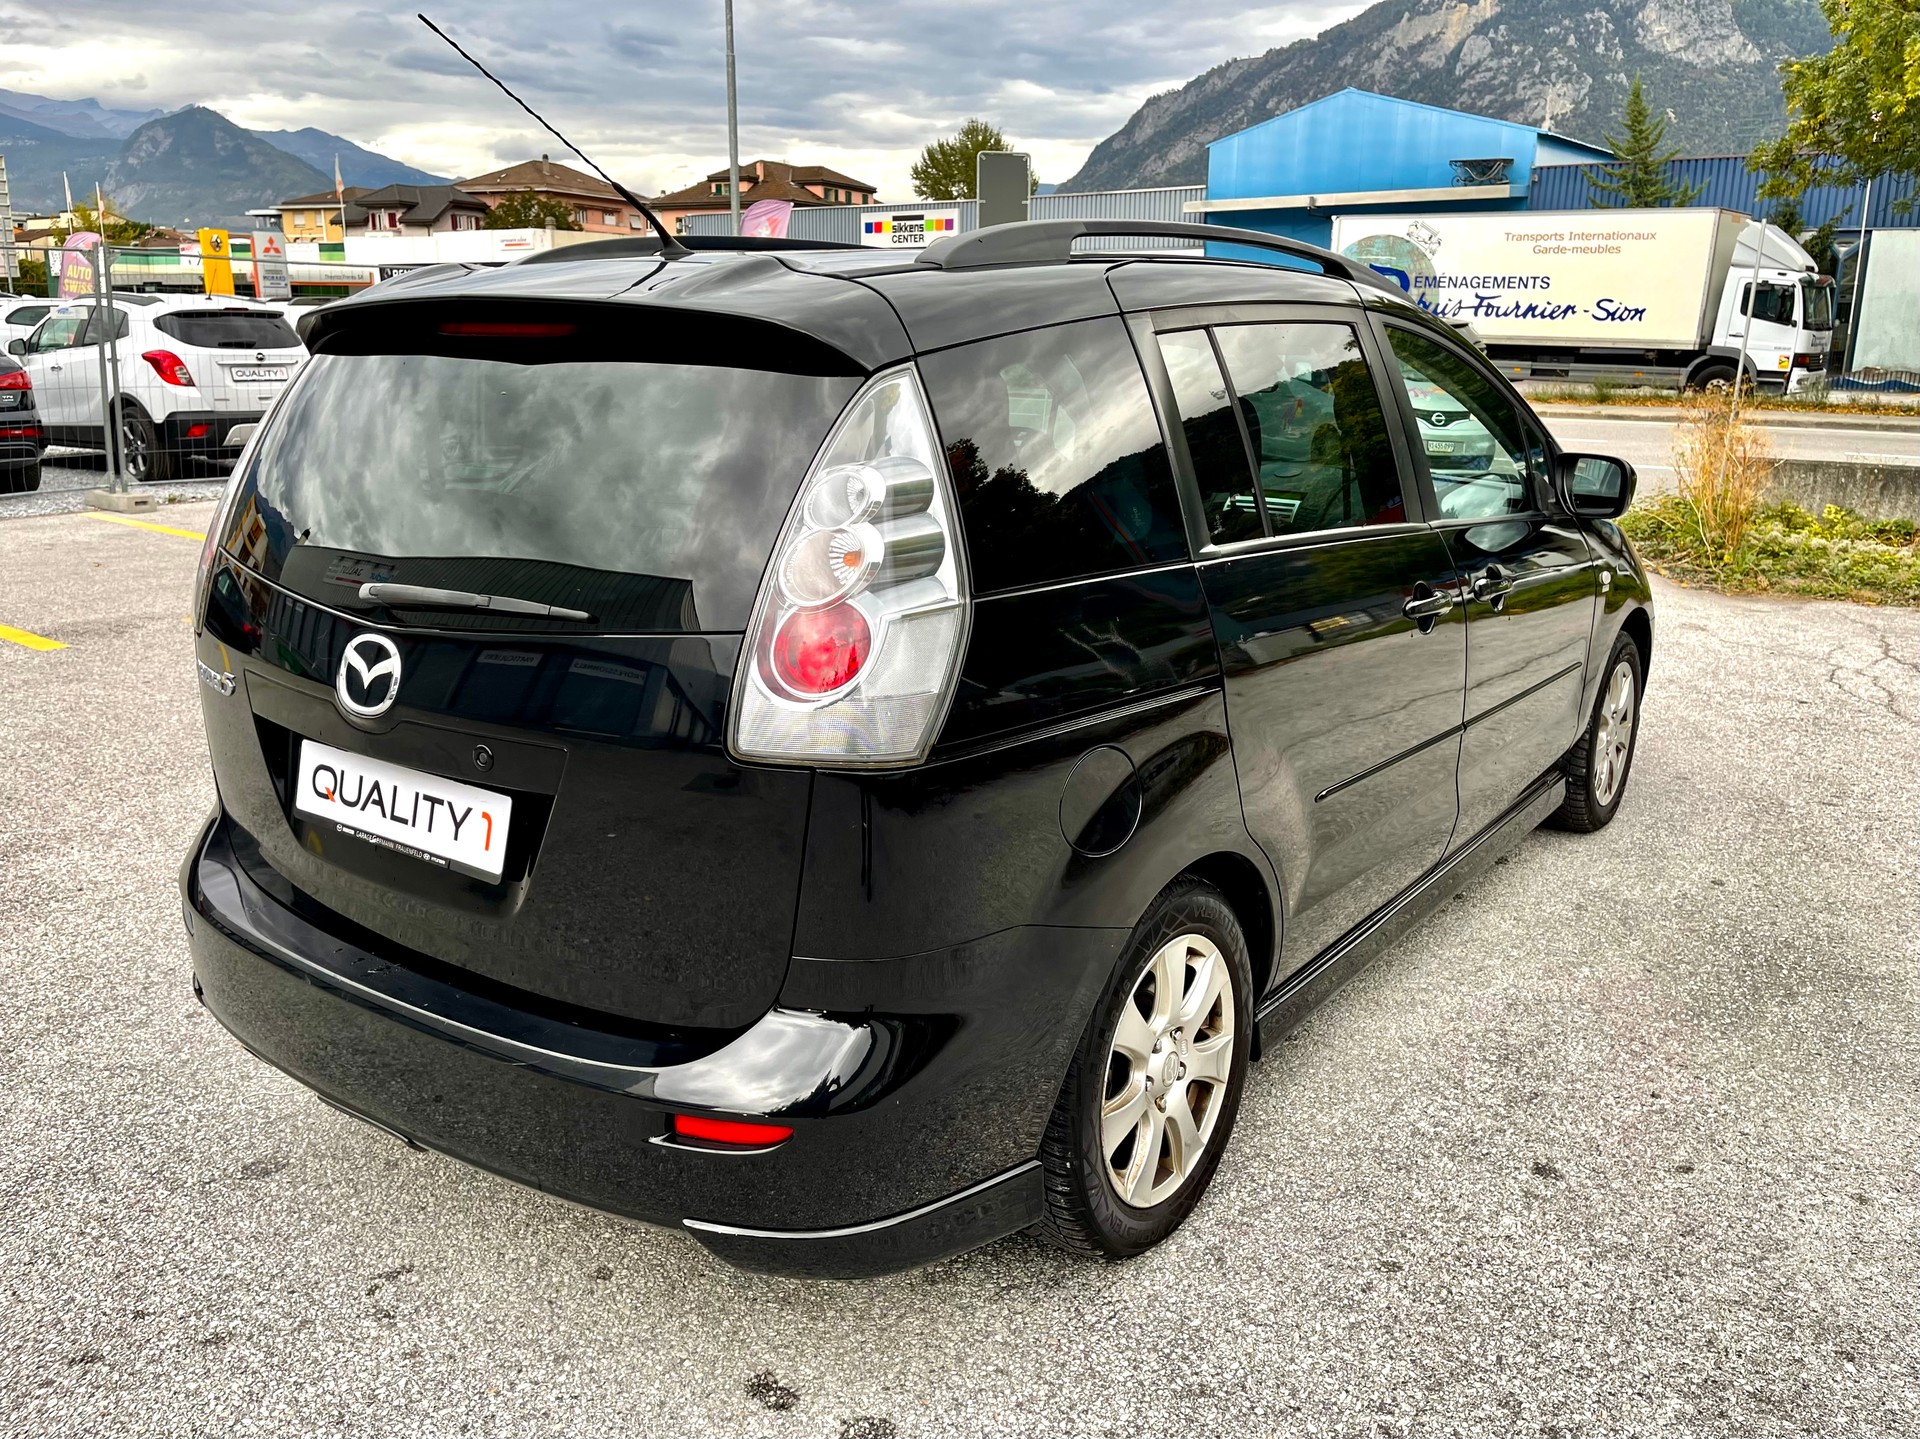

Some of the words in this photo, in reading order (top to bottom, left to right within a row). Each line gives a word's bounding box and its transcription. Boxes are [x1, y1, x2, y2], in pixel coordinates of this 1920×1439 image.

[892, 223, 924, 233] sikkens
[892, 234, 924, 243] CENTER
[1504, 232, 1565, 243] Transports
[1568, 231, 1657, 241] Internationaux
[1532, 244, 1622, 254] Garde-meubles
[67, 265, 92, 280] AUTO
[63, 279, 93, 294] SWISS
[1592, 298, 1647, 321] Sion
[312, 763, 474, 841] QUALITY
[395, 843, 423, 858] FRAUENFELD
